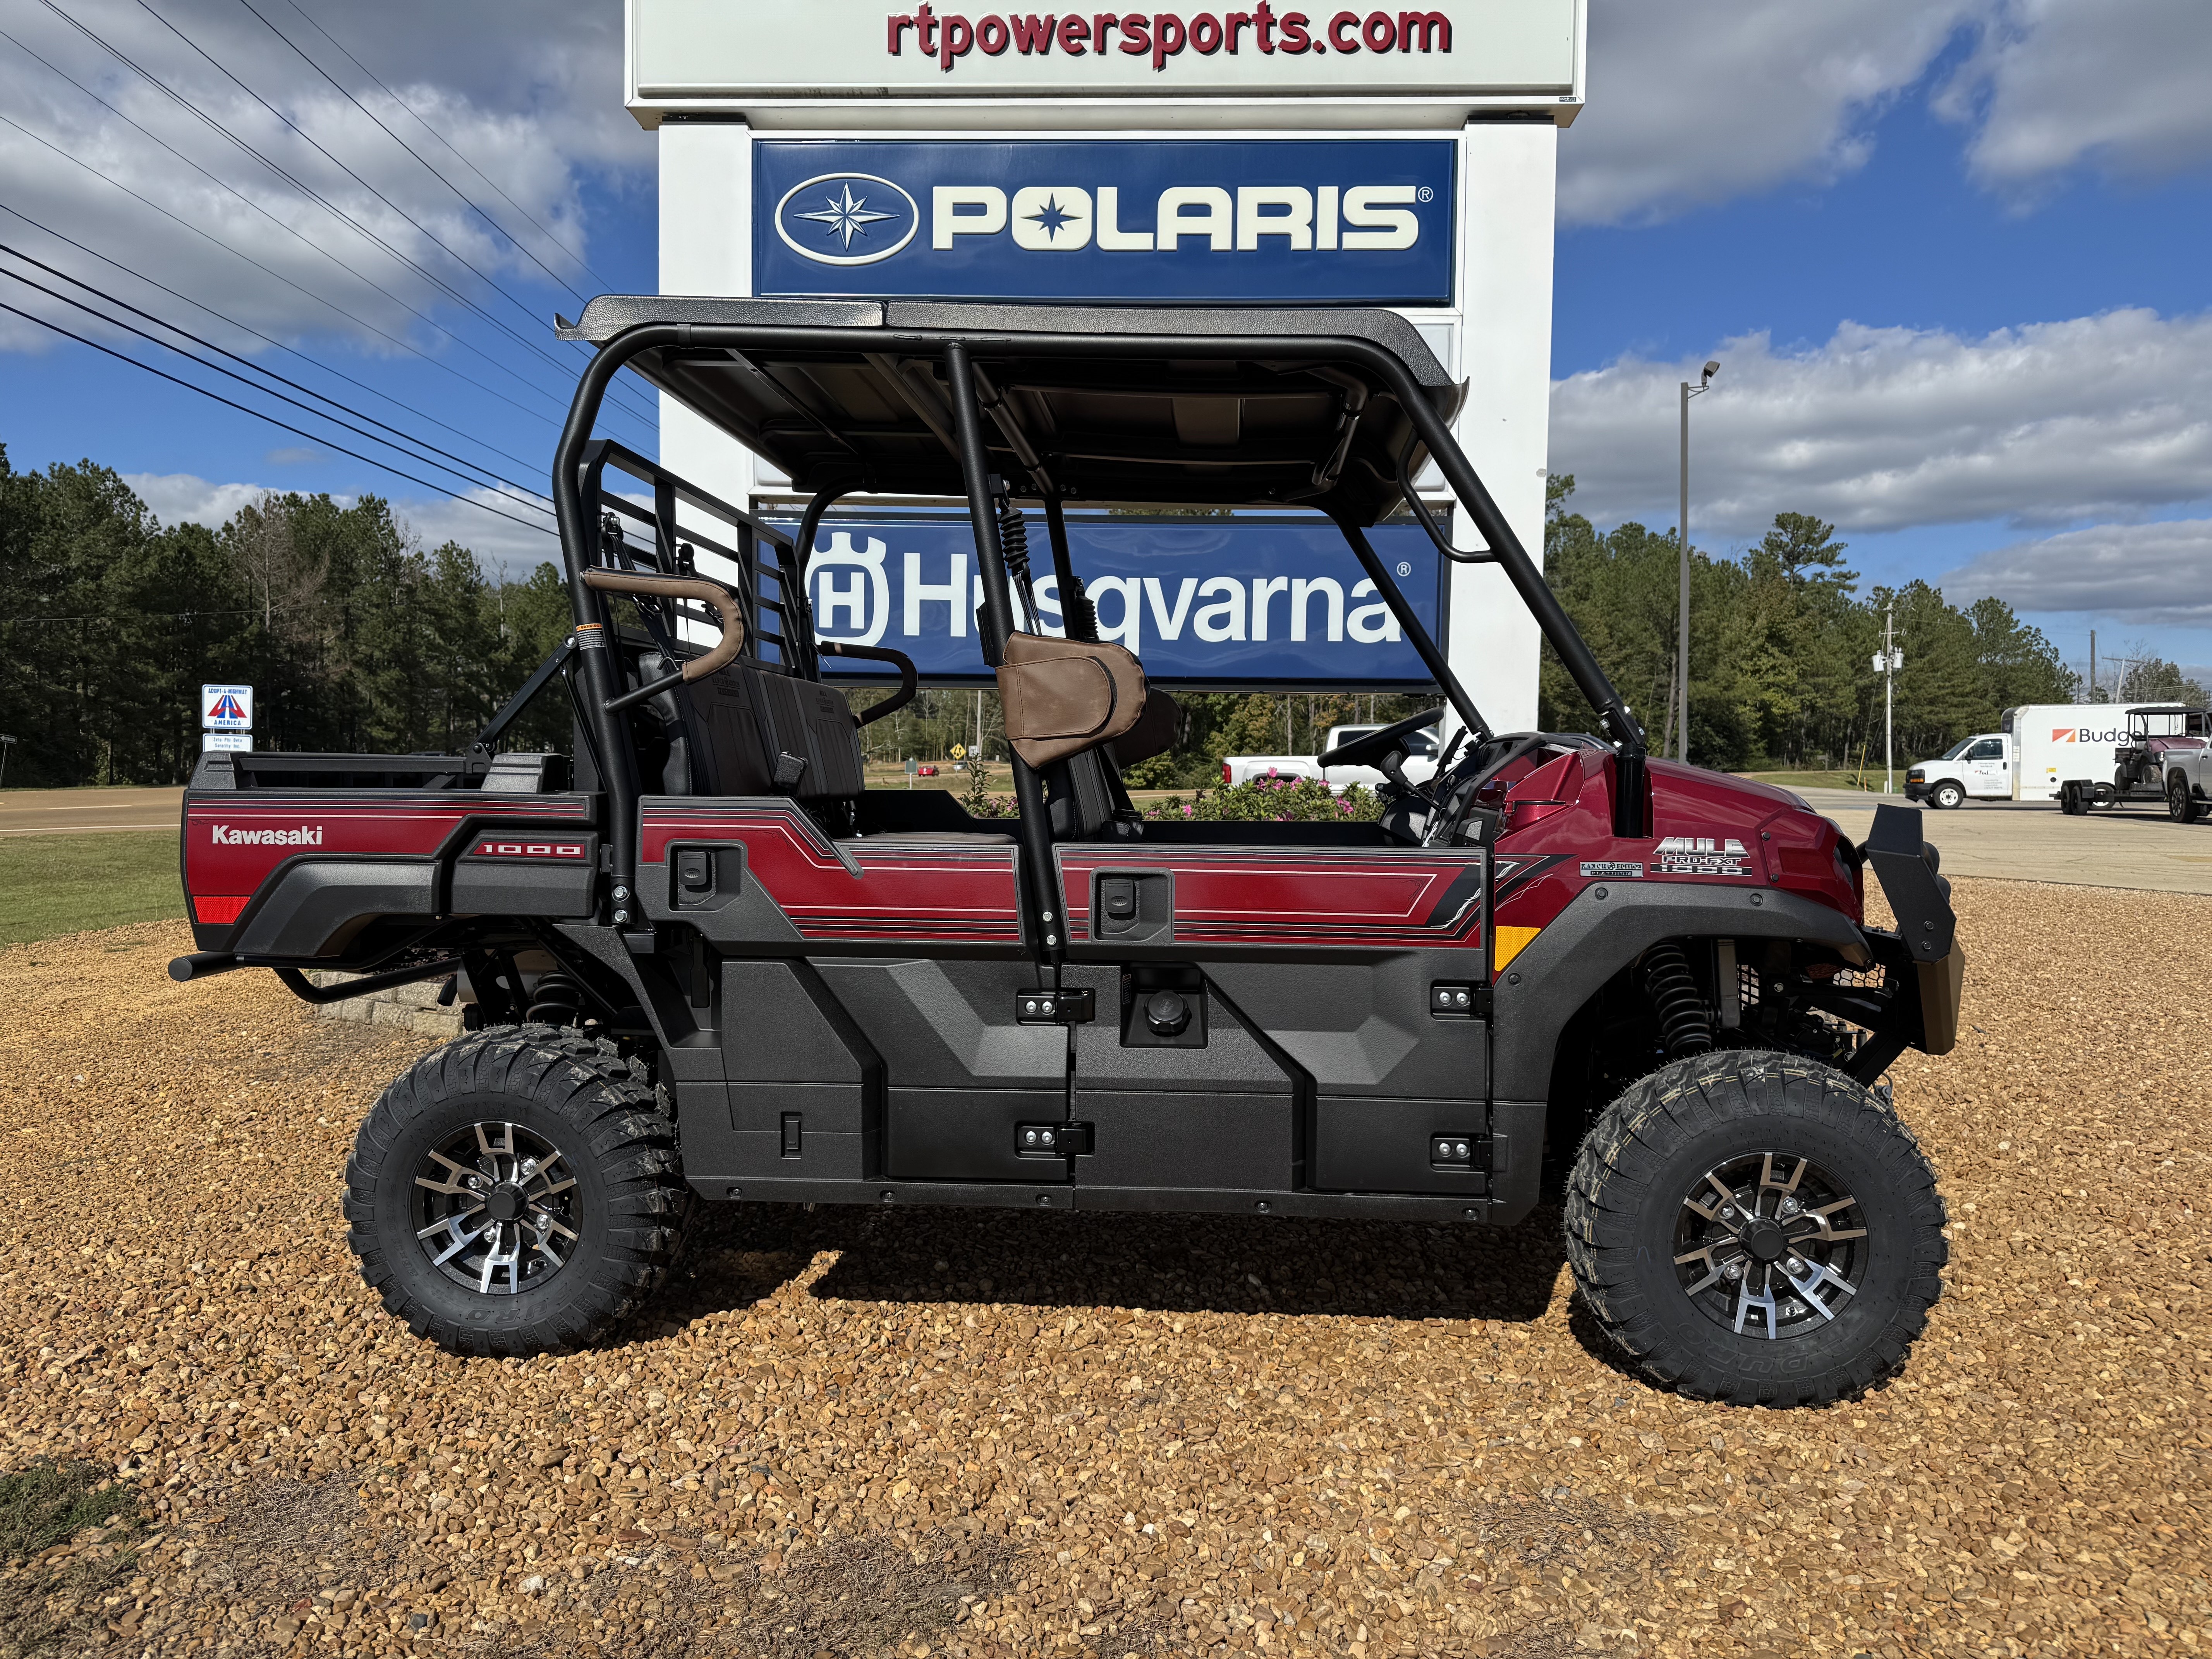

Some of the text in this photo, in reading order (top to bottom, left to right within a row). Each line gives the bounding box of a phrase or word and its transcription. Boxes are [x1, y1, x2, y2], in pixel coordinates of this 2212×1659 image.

[887, 0, 1449, 71] rtpowersports.com
[2079, 728, 2149, 746] Budg
[212, 825, 322, 845] Kawasaki
[484, 845, 580, 855] 1000
[1652, 836, 1751, 858] MULE
[1661, 855, 1741, 866] PRO-FXT
[1660, 865, 1743, 875] 1000
